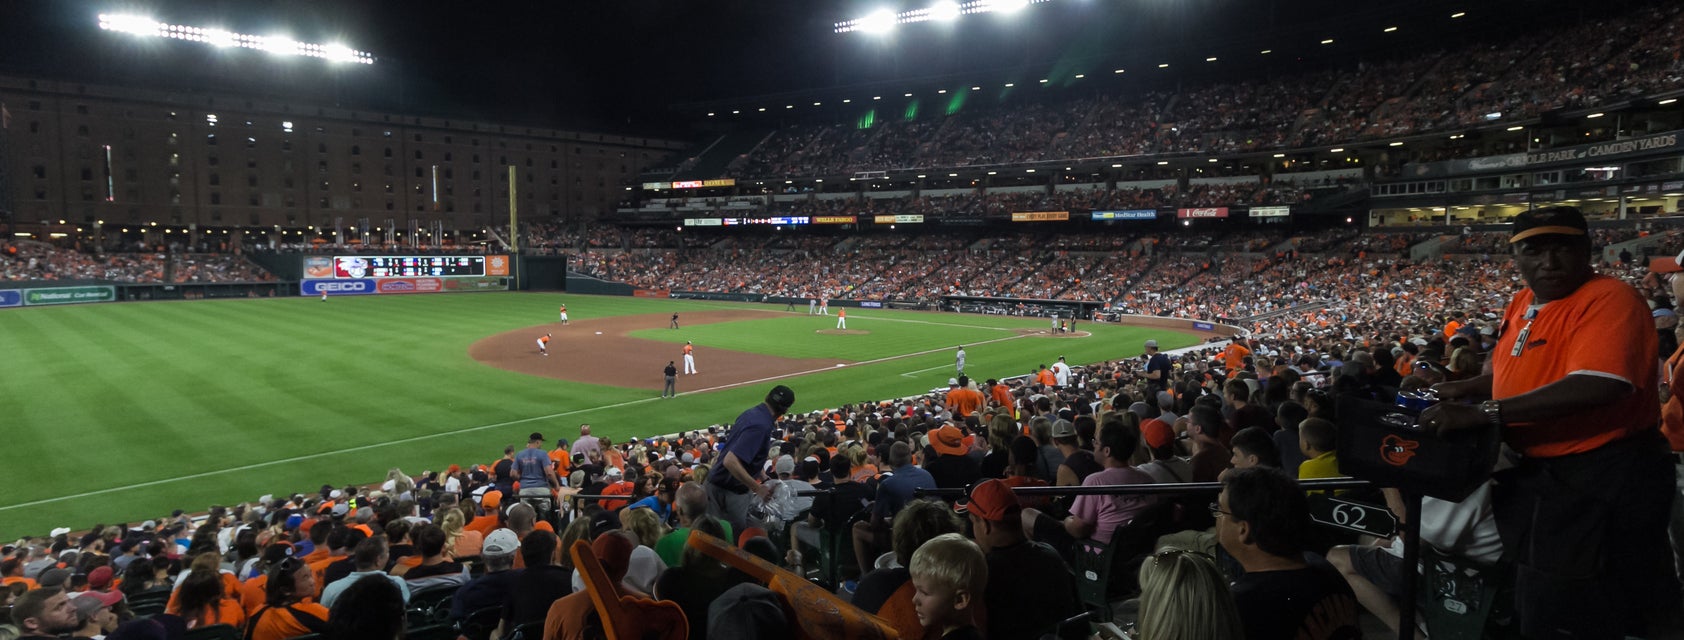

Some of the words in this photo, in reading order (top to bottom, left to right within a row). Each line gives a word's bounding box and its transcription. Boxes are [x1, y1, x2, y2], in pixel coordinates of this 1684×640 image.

[1507, 153, 1548, 167] ORIOLE
[1549, 150, 1577, 162] PARK
[1589, 140, 1637, 156] CAMDEN
[1637, 135, 1677, 150] YARDS
[315, 282, 366, 292] GEICO
[1332, 503, 1367, 529] 62
